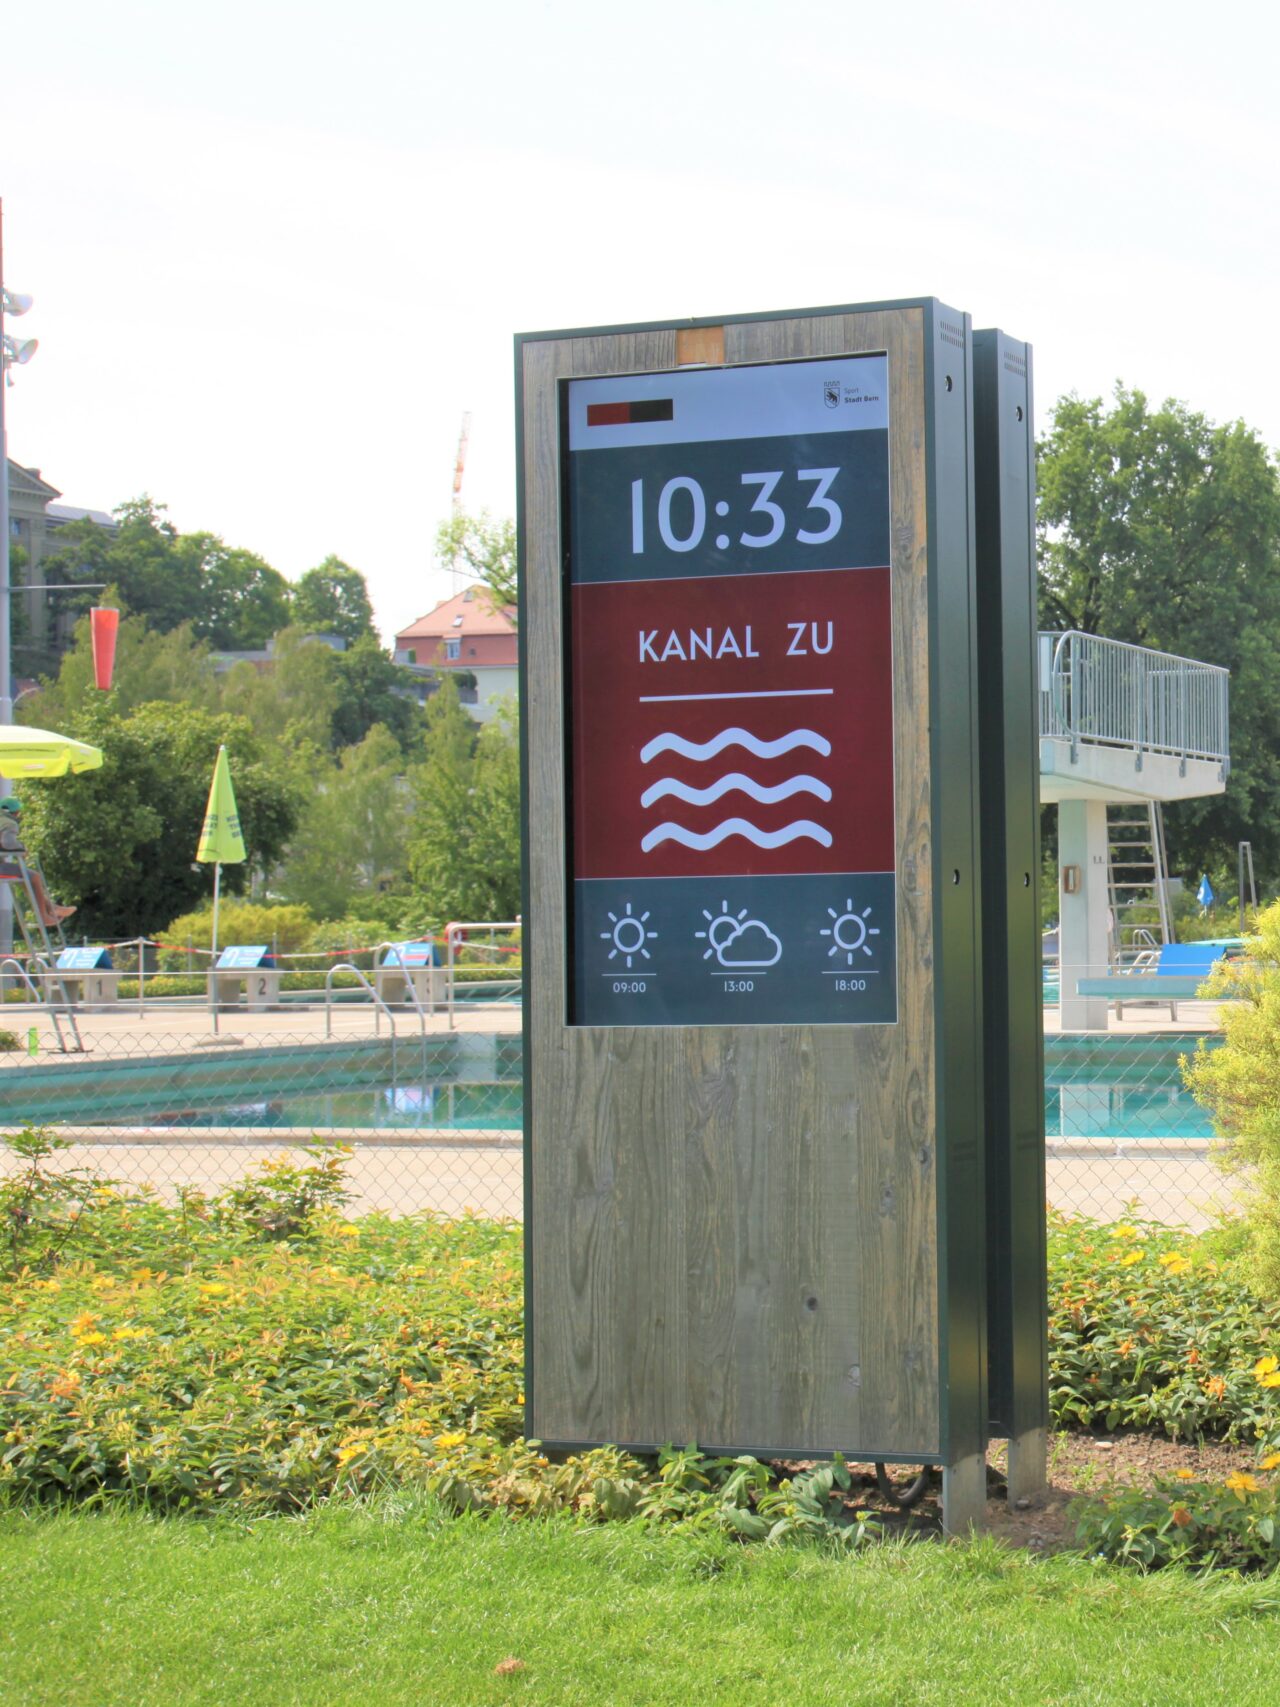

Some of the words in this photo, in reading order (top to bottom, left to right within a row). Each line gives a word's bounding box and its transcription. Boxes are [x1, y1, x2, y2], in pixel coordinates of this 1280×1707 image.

[631, 466, 843, 554] 10:33
[639, 625, 760, 663] KANAL
[786, 621, 835, 656] ZU
[258, 978, 266, 995] 2
[612, 981, 647, 993] 09:00
[724, 980, 754, 993] 13:00
[835, 979, 866, 992] 18:00
